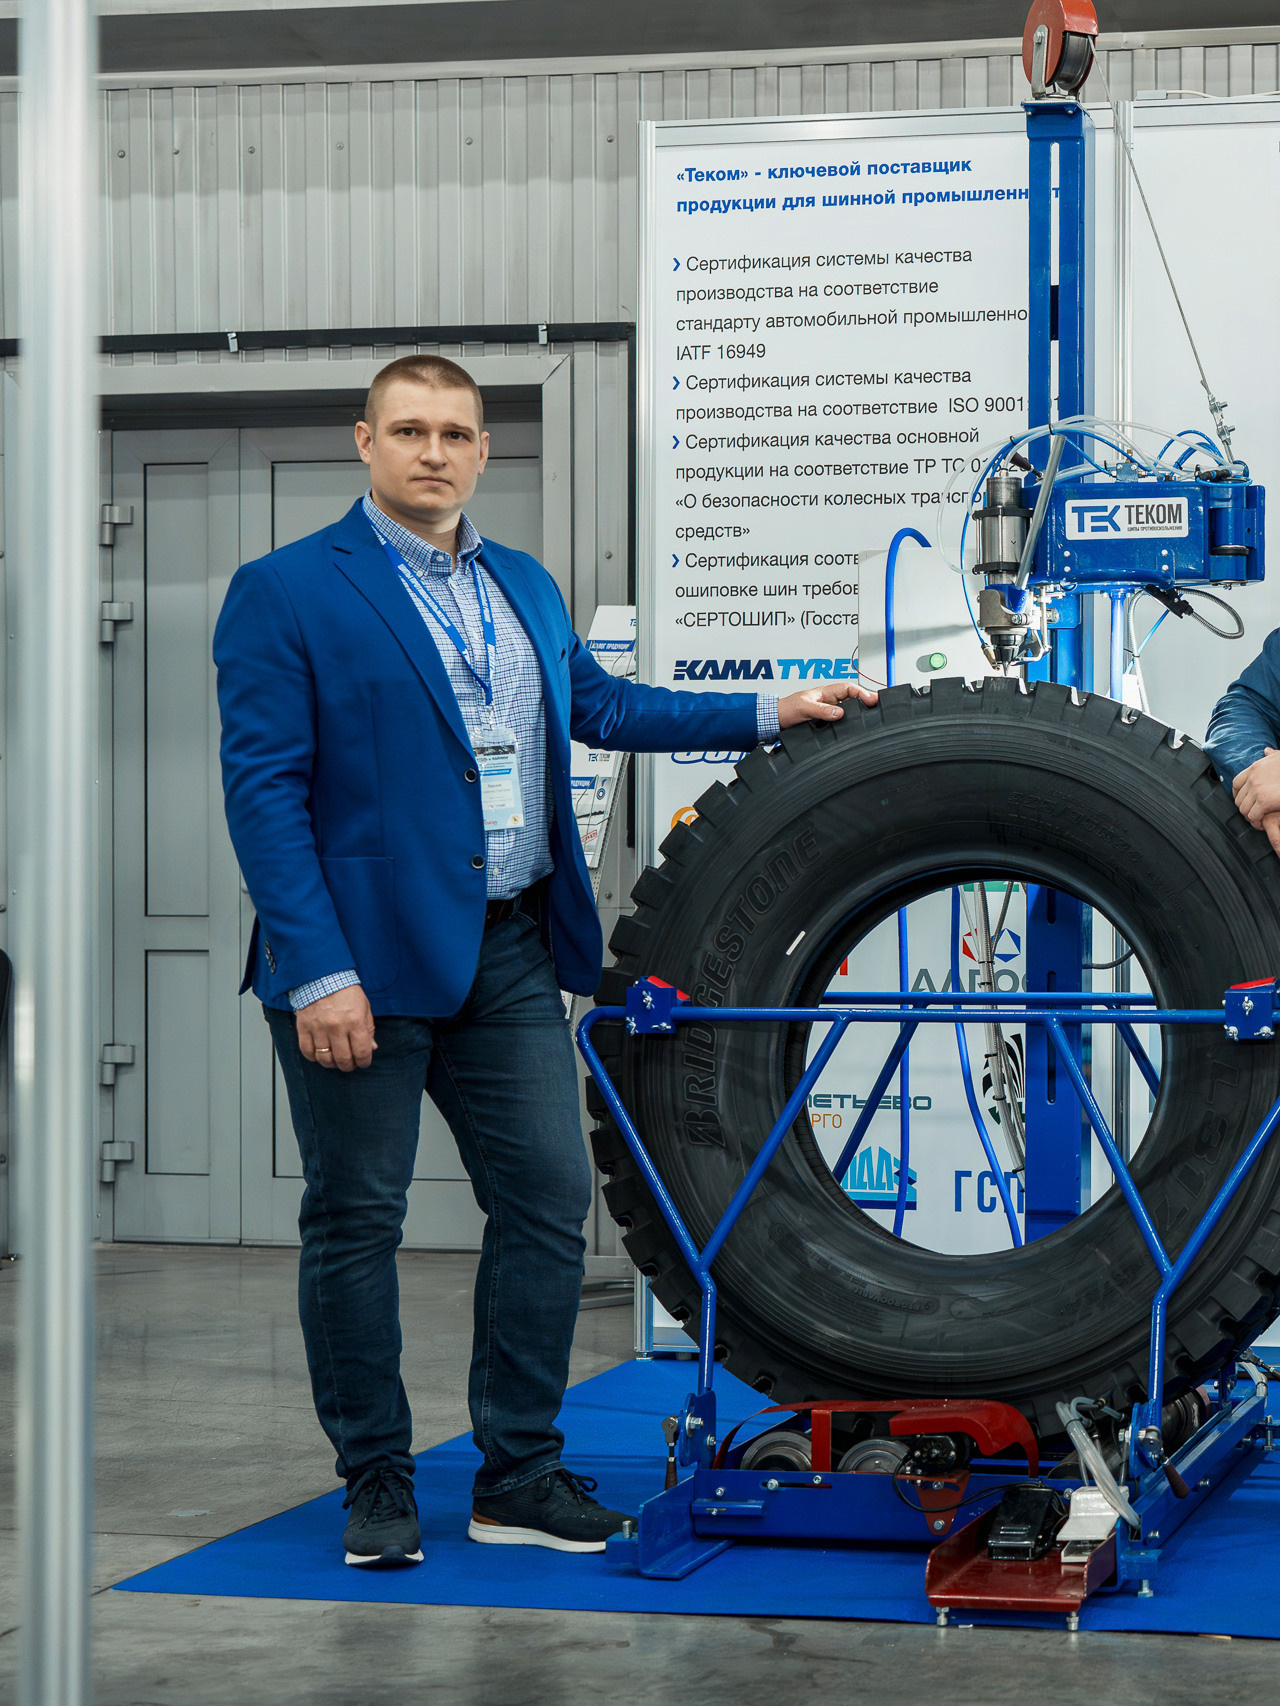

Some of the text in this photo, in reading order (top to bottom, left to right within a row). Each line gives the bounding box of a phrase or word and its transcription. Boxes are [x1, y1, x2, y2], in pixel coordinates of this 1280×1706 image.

[677, 168, 748, 182] «Теком»
[768, 161, 860, 179] ключевой
[868, 161, 972, 175] поставщик
[677, 198, 775, 215] продукции
[782, 197, 815, 211] для
[823, 190, 895, 206] шинной
[687, 251, 972, 274] Сертификация системы качества
[677, 282, 938, 304] производства на соответствие
[677, 309, 1027, 332] стандарту автомобильной промышленно
[677, 344, 765, 360] IATF 16949
[686, 371, 971, 393] Сертификация системы качества
[677, 406, 792, 423] производства
[798, 405, 817, 416] на
[823, 402, 937, 416] соответствие
[949, 397, 979, 412] ISO
[686, 427, 979, 452] Сертификация качества основной
[676, 466, 763, 482] продукции
[770, 466, 789, 476] на
[794, 463, 908, 476] соответствие
[914, 459, 936, 473] ТР
[676, 494, 696, 508] «О
[702, 494, 818, 508] безопасности
[825, 493, 905, 505] колесных
[1125, 503, 1182, 525] ТЕКОМ
[676, 526, 750, 541] средств»
[686, 552, 858, 571] Сертификация соотв
[676, 580, 858, 600] ошиповке шин требов
[676, 610, 858, 630] «СЕРТОШИП» (Госста
[673, 659, 774, 681] KAMA
[811, 1113, 842, 1129] РГО
